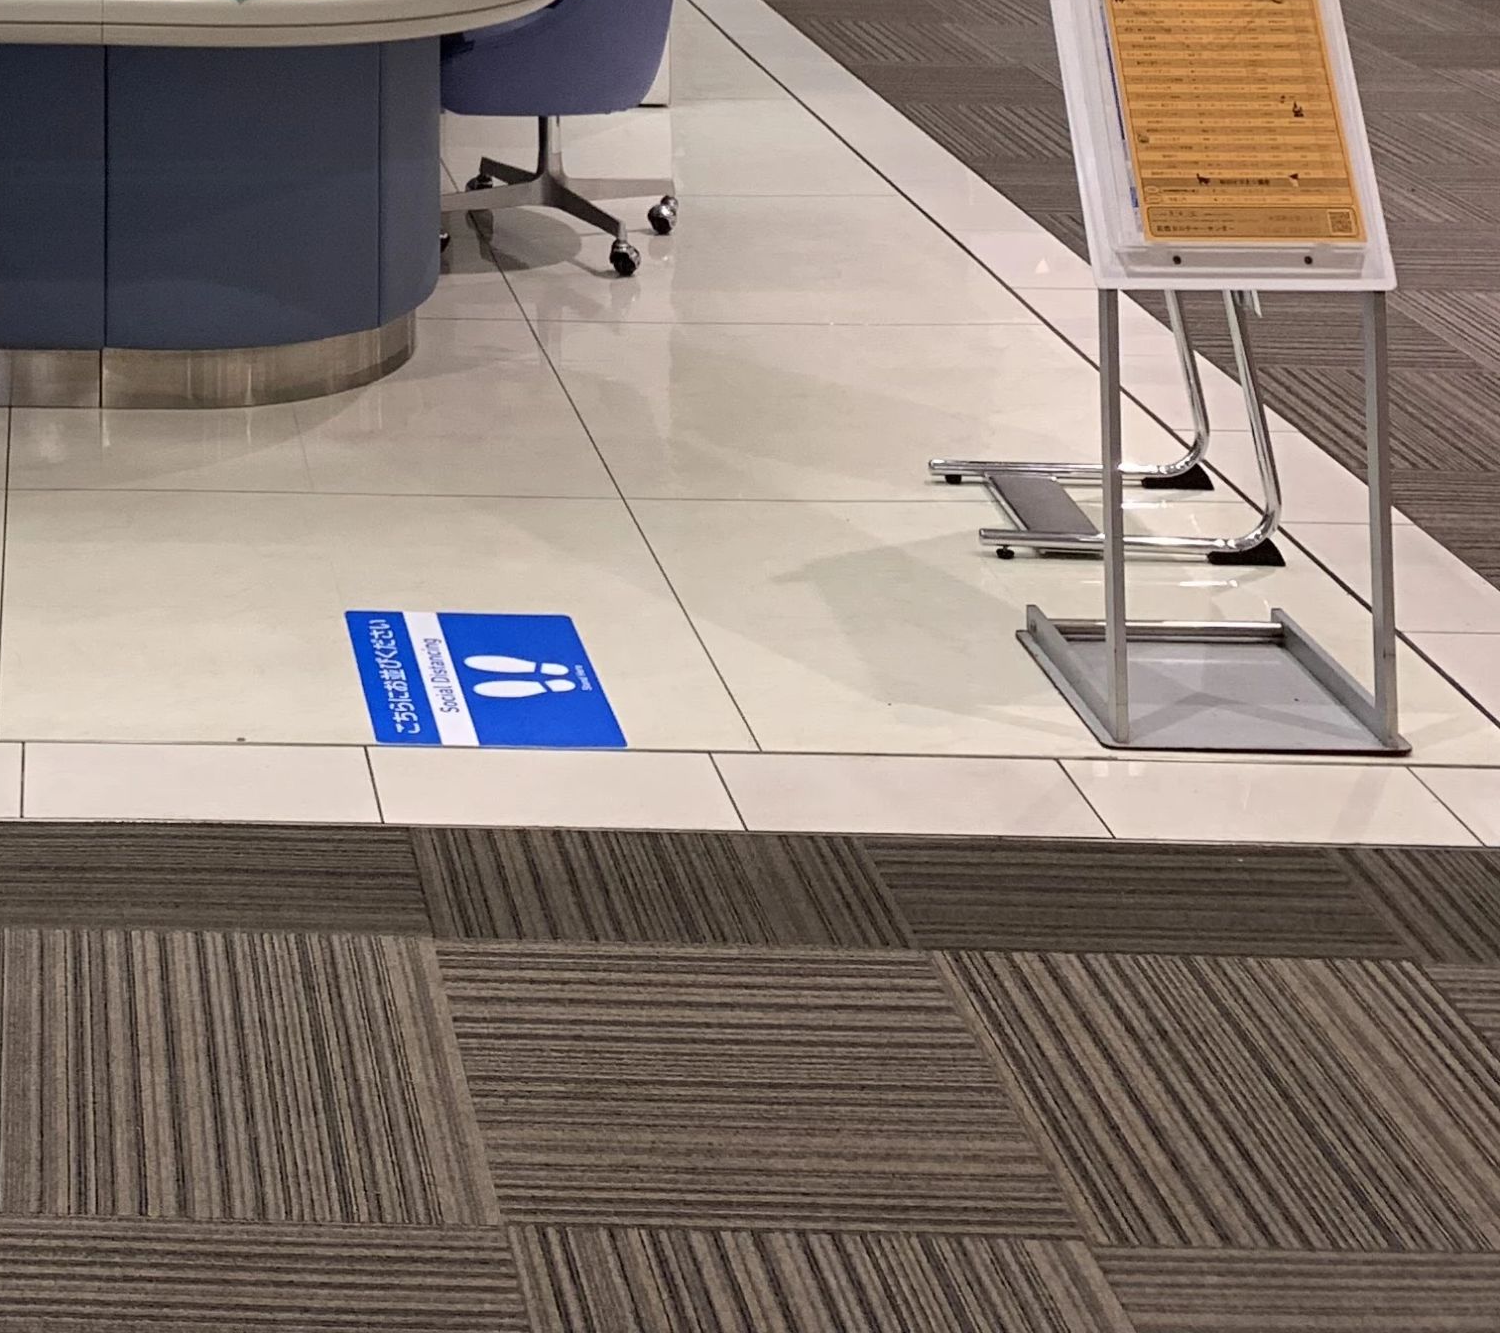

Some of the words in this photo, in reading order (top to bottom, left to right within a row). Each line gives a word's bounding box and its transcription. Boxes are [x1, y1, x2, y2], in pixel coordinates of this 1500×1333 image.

[368, 619, 421, 735] こちらにお並びください
[420, 638, 450, 683] Distancing
[432, 685, 460, 713] Social
